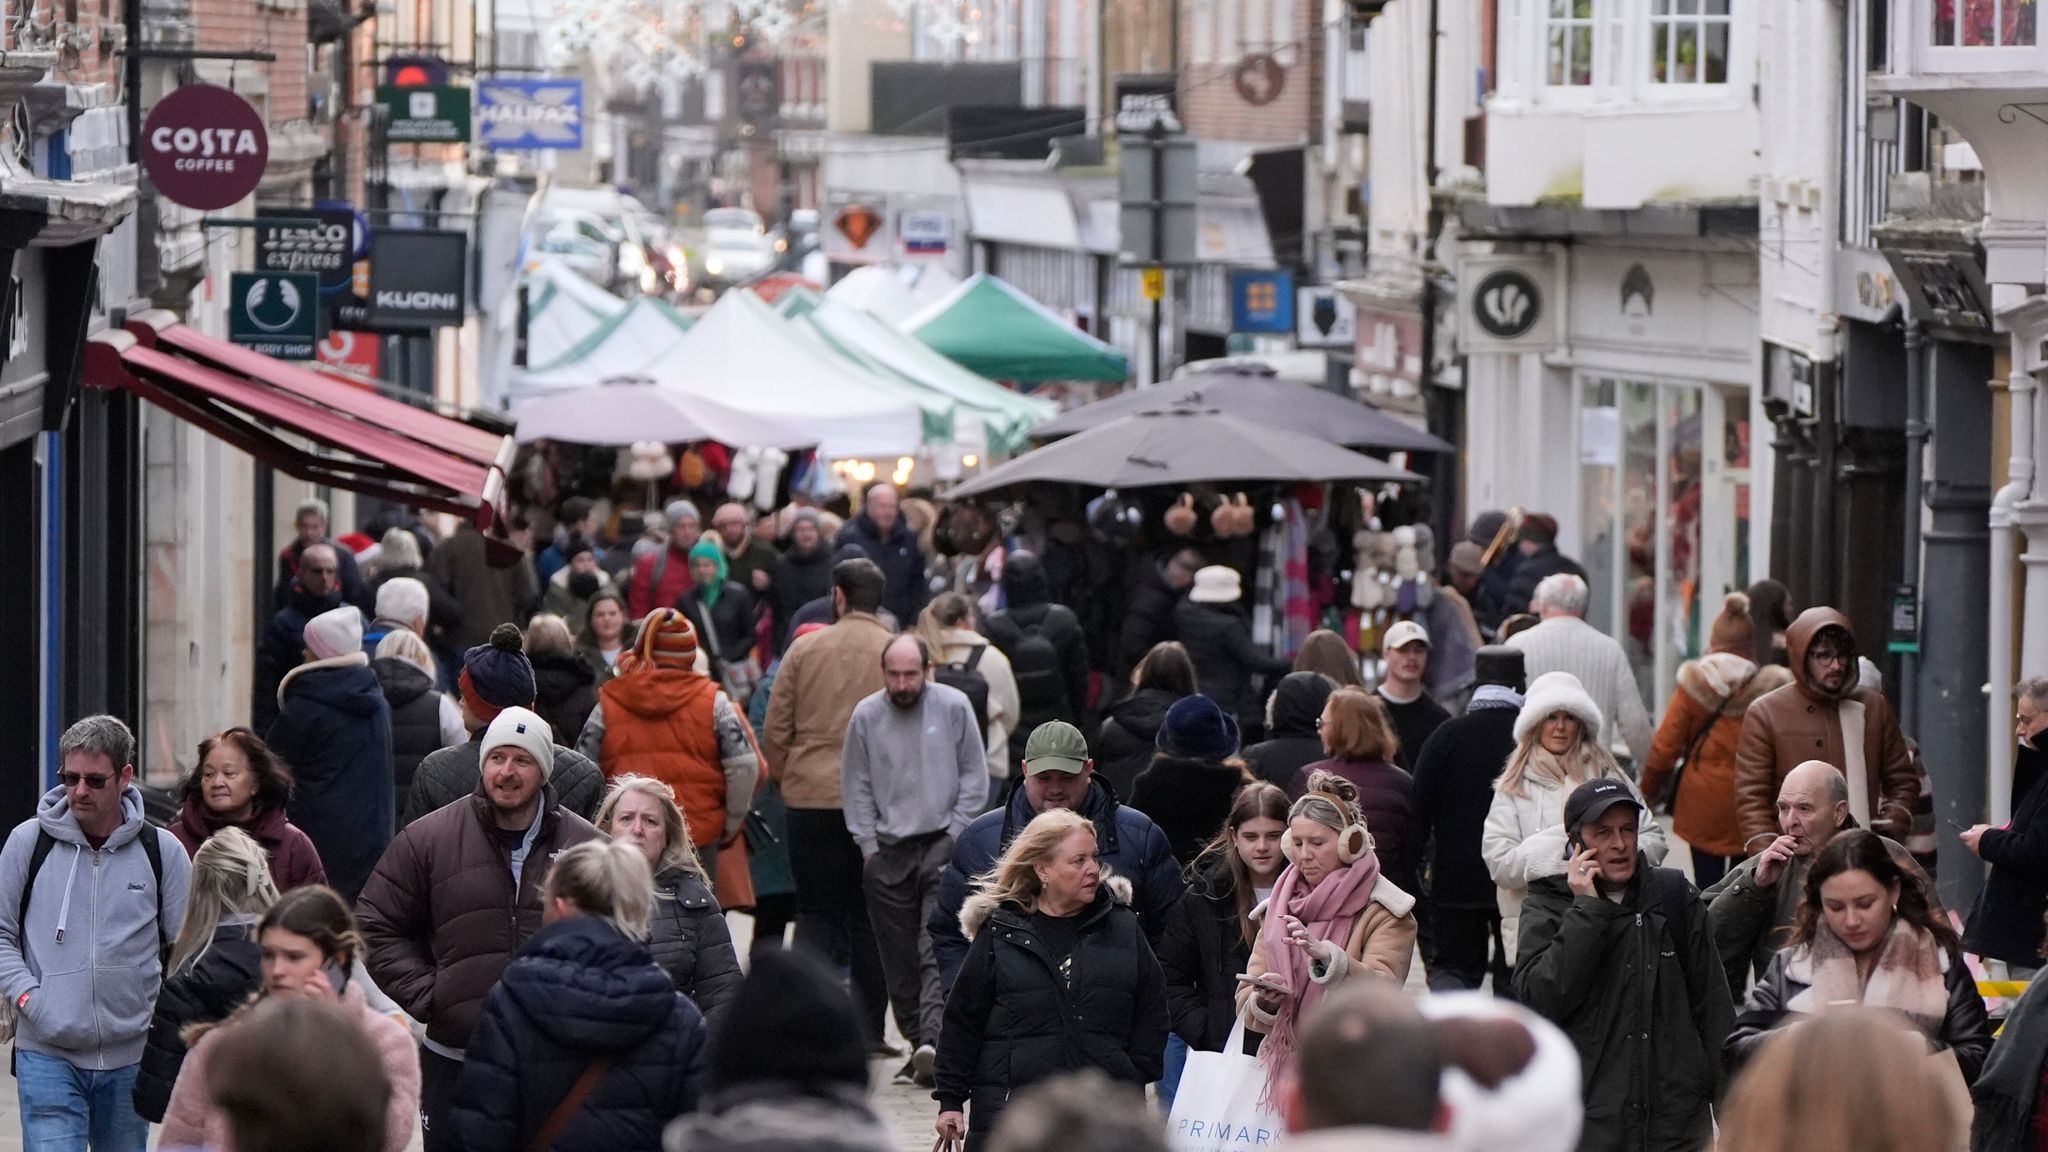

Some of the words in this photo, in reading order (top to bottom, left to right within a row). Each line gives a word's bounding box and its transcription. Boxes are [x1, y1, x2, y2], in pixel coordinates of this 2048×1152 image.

[150, 126, 258, 157] COSTA
[174, 158, 235, 173] COFFEE
[376, 291, 456, 310] KUONI
[283, 343, 313, 357] SHOP
[1177, 1118, 1283, 1147] PRIMARK
